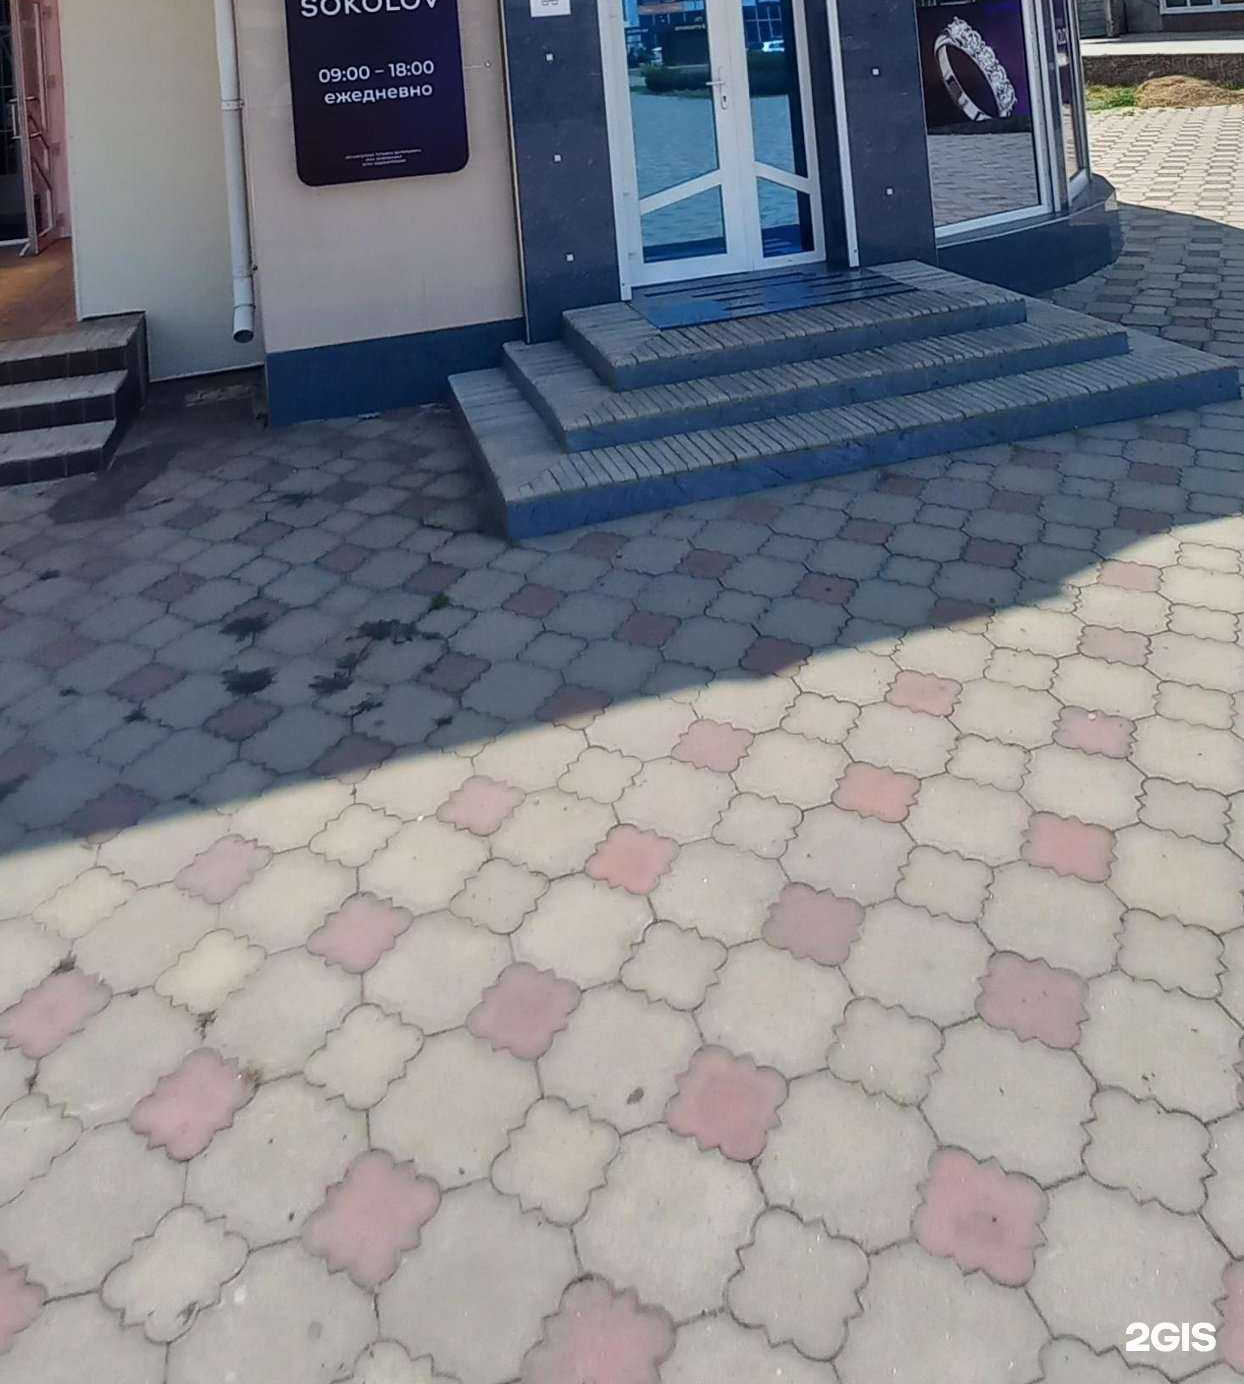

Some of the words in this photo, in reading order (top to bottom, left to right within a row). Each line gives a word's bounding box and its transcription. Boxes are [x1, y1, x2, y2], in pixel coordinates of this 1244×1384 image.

[318, 65, 371, 83] 09:00
[387, 60, 435, 78] 18:00
[323, 84, 433, 104] ежедневно
